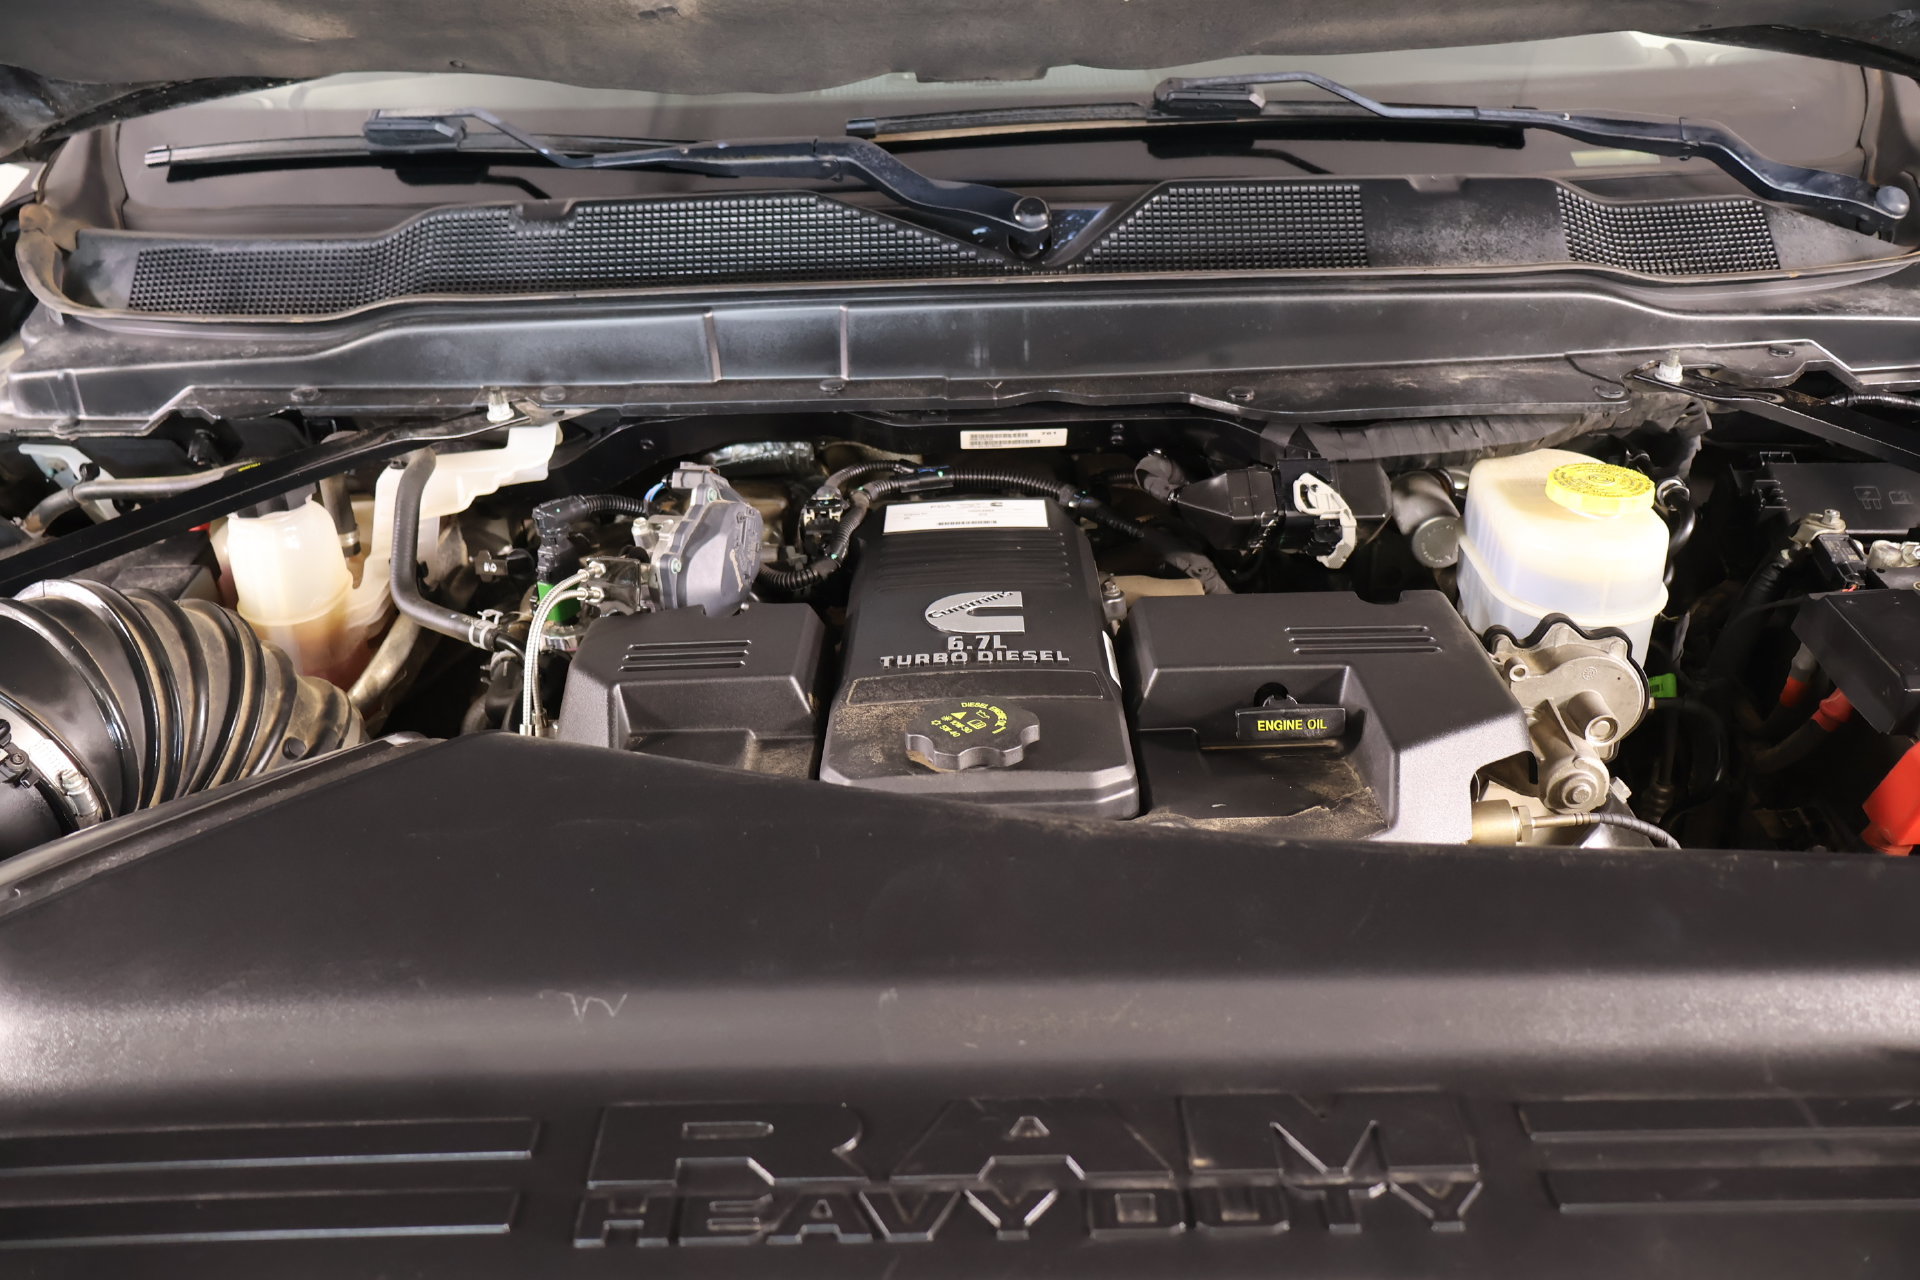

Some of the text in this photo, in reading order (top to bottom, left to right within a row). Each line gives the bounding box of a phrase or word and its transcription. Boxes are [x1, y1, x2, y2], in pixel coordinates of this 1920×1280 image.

[928, 590, 1014, 619] Cummins
[947, 635, 1008, 650] 6.7L
[879, 650, 1070, 669] TURBO DIESEL
[1257, 718, 1328, 731] ENGINE OIL
[586, 1086, 1480, 1187] RAM
[573, 1188, 1059, 1248] HEAVY
